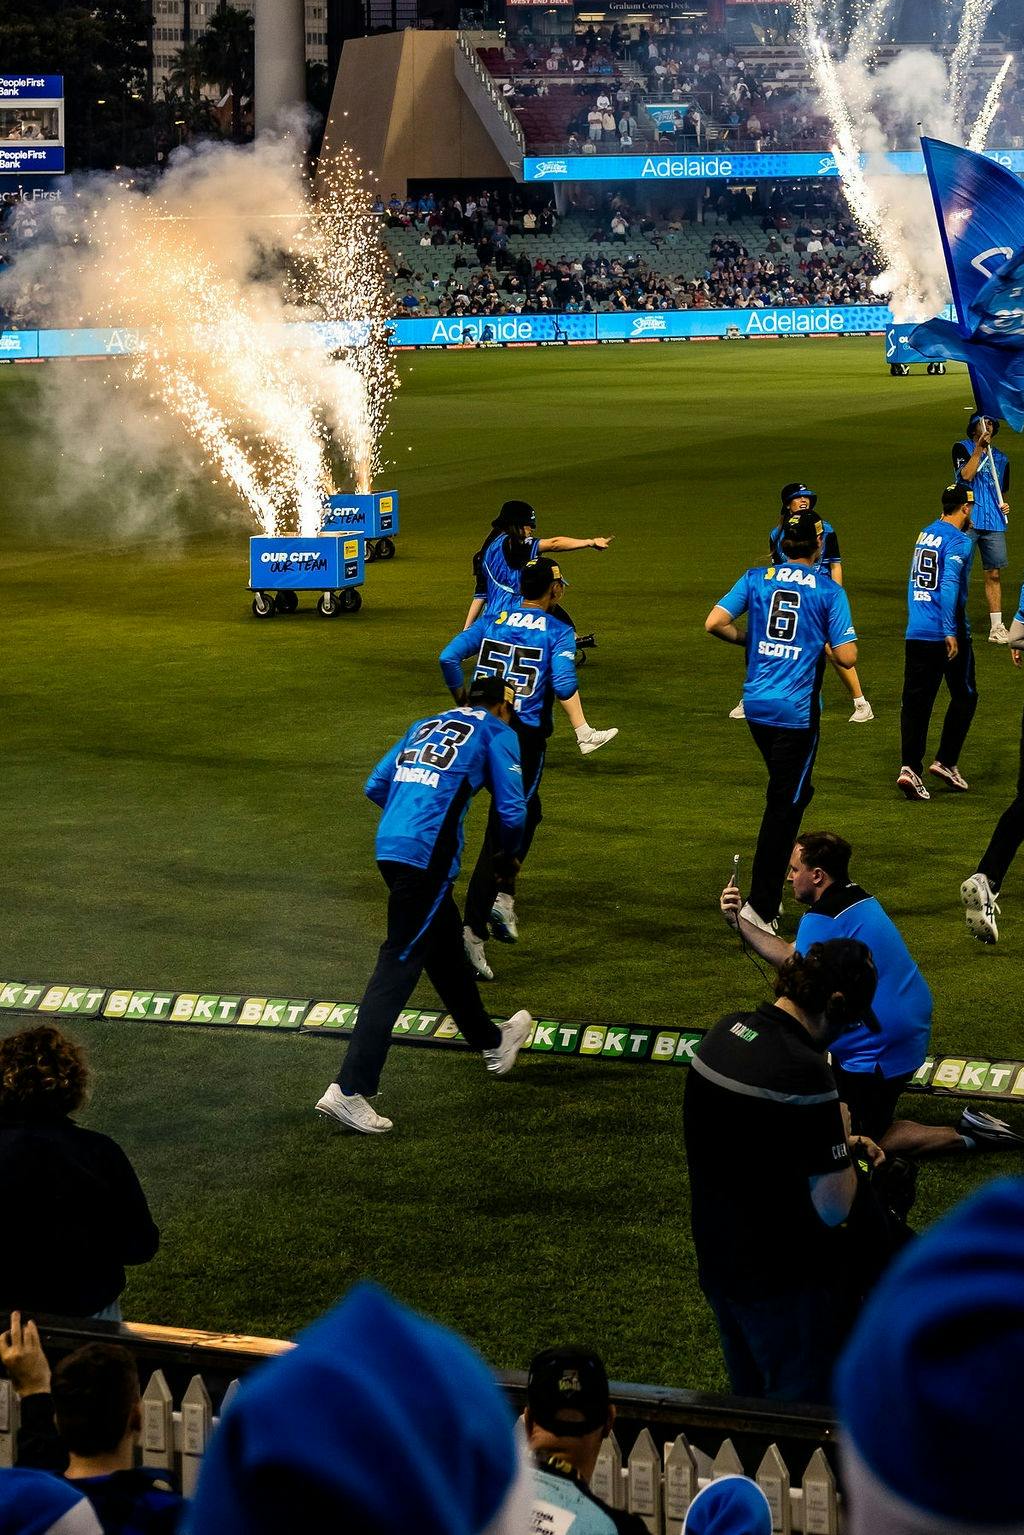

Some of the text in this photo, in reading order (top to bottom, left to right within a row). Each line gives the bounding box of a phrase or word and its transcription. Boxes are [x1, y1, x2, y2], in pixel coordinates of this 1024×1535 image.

[609, 2, 641, 10] Graham
[642, 2, 669, 10] Cornes
[641, 157, 732, 176] Adelaide
[32, 188, 62, 202] First
[746, 309, 844, 333] Adelaide
[333, 507, 359, 517] CITY
[339, 513, 365, 525] TEAM
[261, 552, 321, 563] OUR CITY
[270, 559, 328, 573] OUR TEAM
[776, 567, 817, 588] RAA
[507, 612, 547, 632] RAA
[766, 589, 801, 642] 6
[757, 640, 803, 661] SCOTT
[473, 637, 545, 698] 55
[396, 719, 475, 771] 23
[0, 987, 42, 1005] KT
[42, 990, 103, 1009] BKT
[107, 994, 170, 1014] BKT
[173, 998, 237, 1019] BKT
[240, 1003, 305, 1023] BKT
[393, 1013, 437, 1032] KT
[526, 1026, 578, 1047] KT
[583, 1031, 648, 1052] BKT
[655, 1035, 700, 1057] BK
[938, 1065, 1011, 1088] BKT
